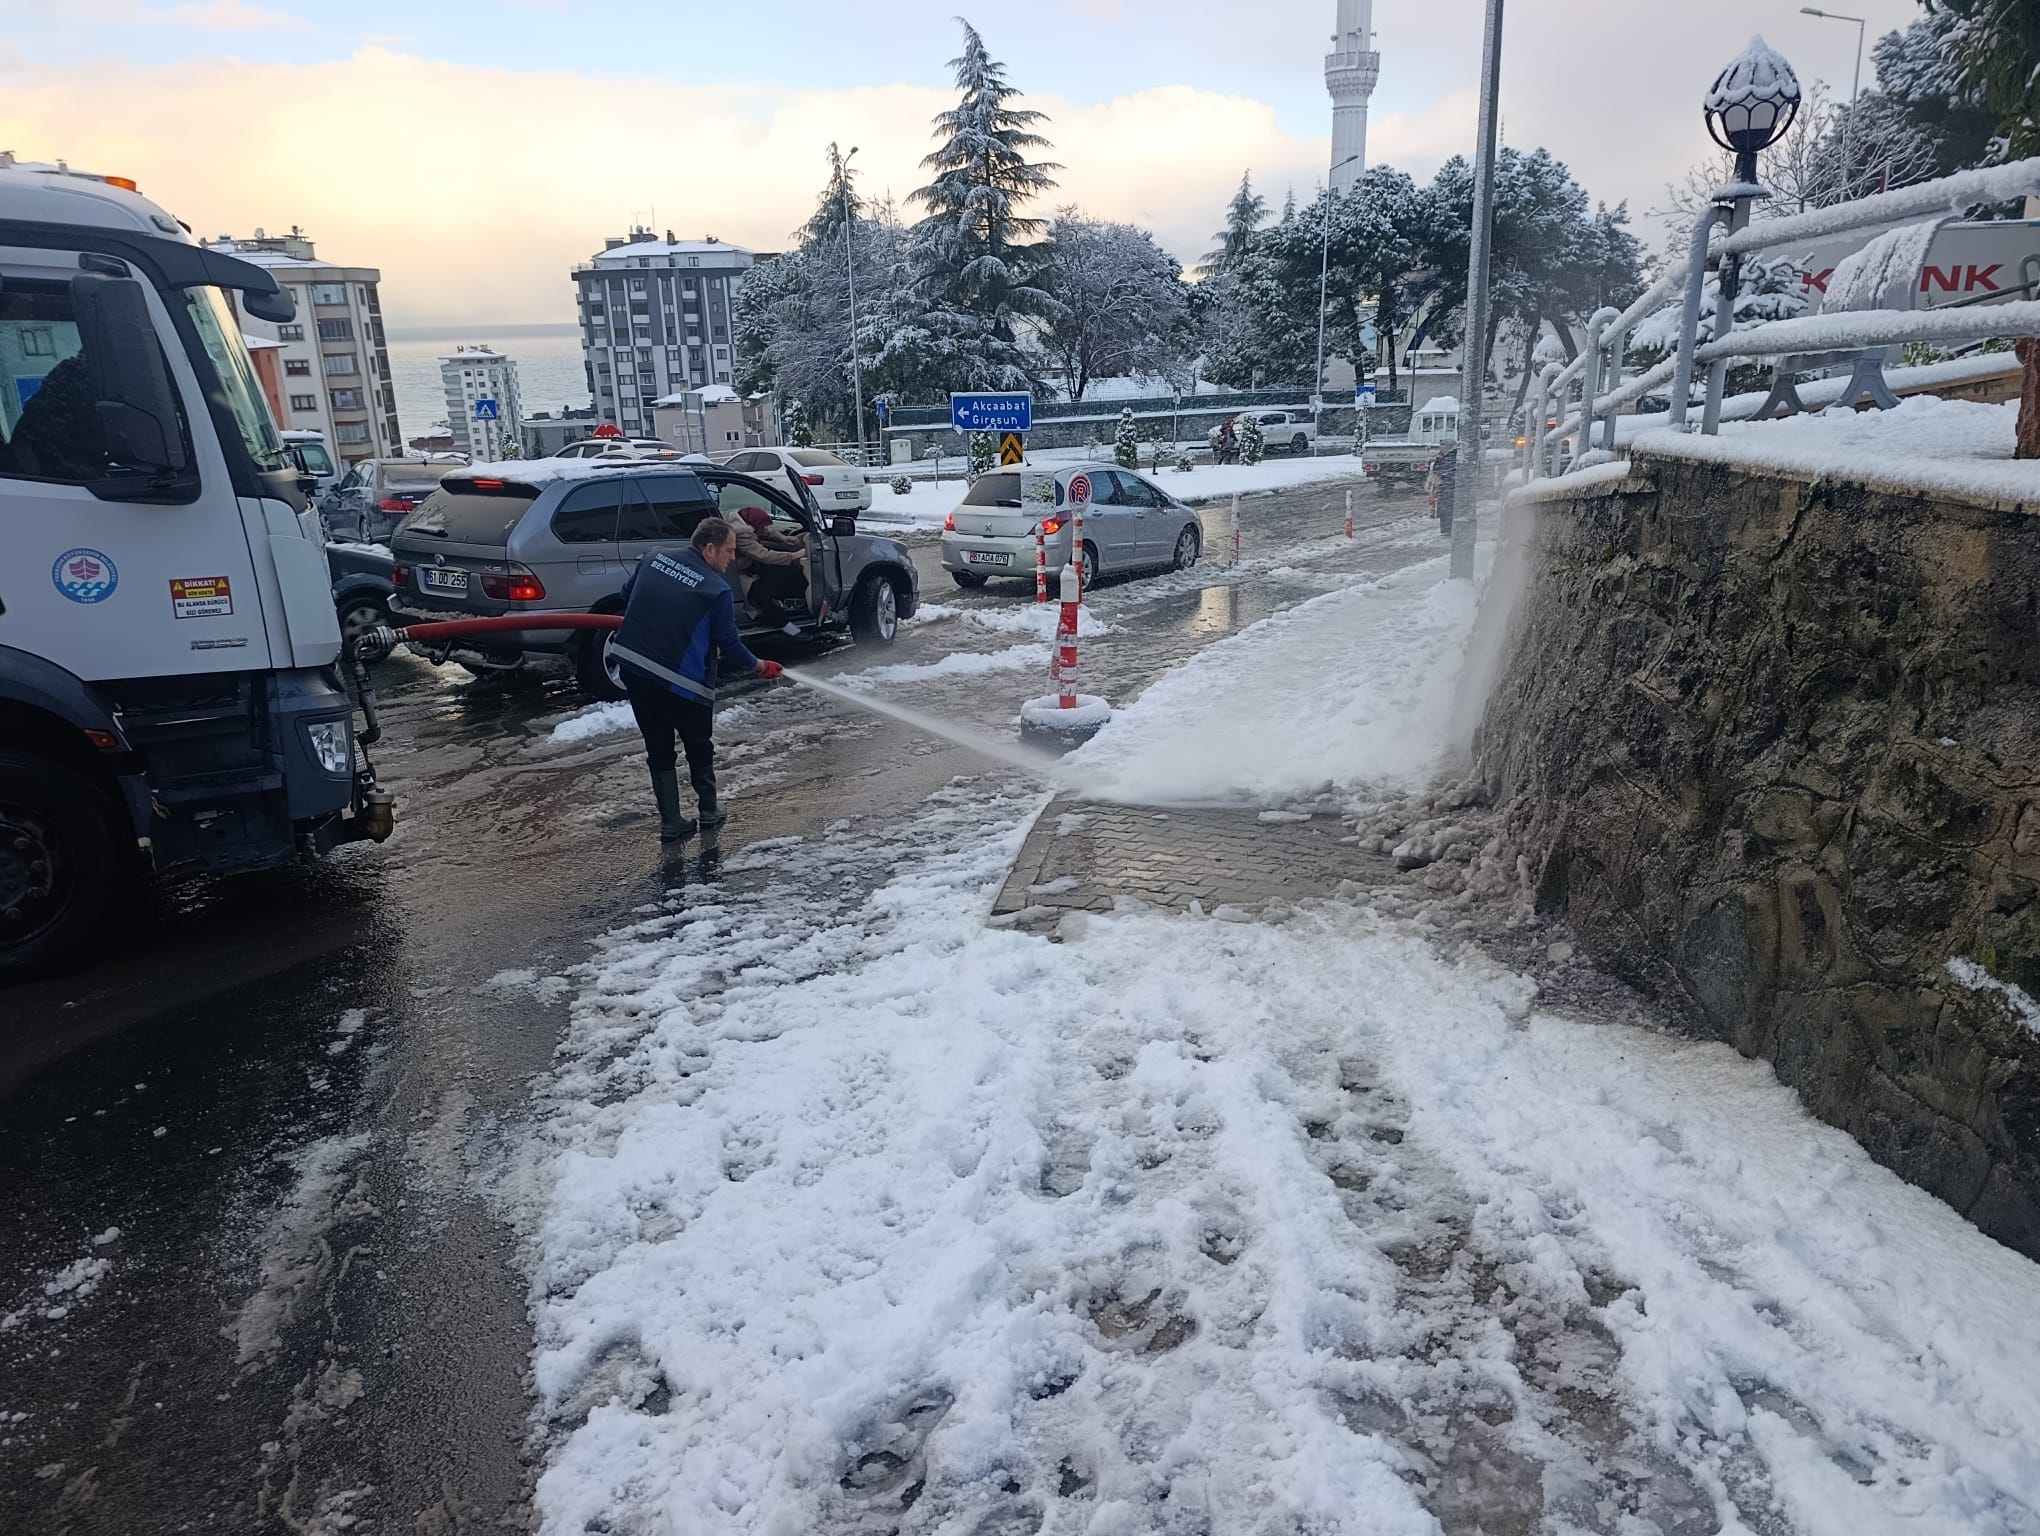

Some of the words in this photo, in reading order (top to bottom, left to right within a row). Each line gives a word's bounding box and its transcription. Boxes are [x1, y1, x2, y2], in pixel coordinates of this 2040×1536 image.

[972, 401, 1025, 411] Akçaabat
[972, 415, 1018, 425] Giresun
[429, 571, 437, 582] 61
[438, 573, 449, 585] DD
[451, 574, 467, 587] 255
[650, 560, 699, 588] BELEDİYESİ
[184, 580, 216, 588] DİKKAT!
